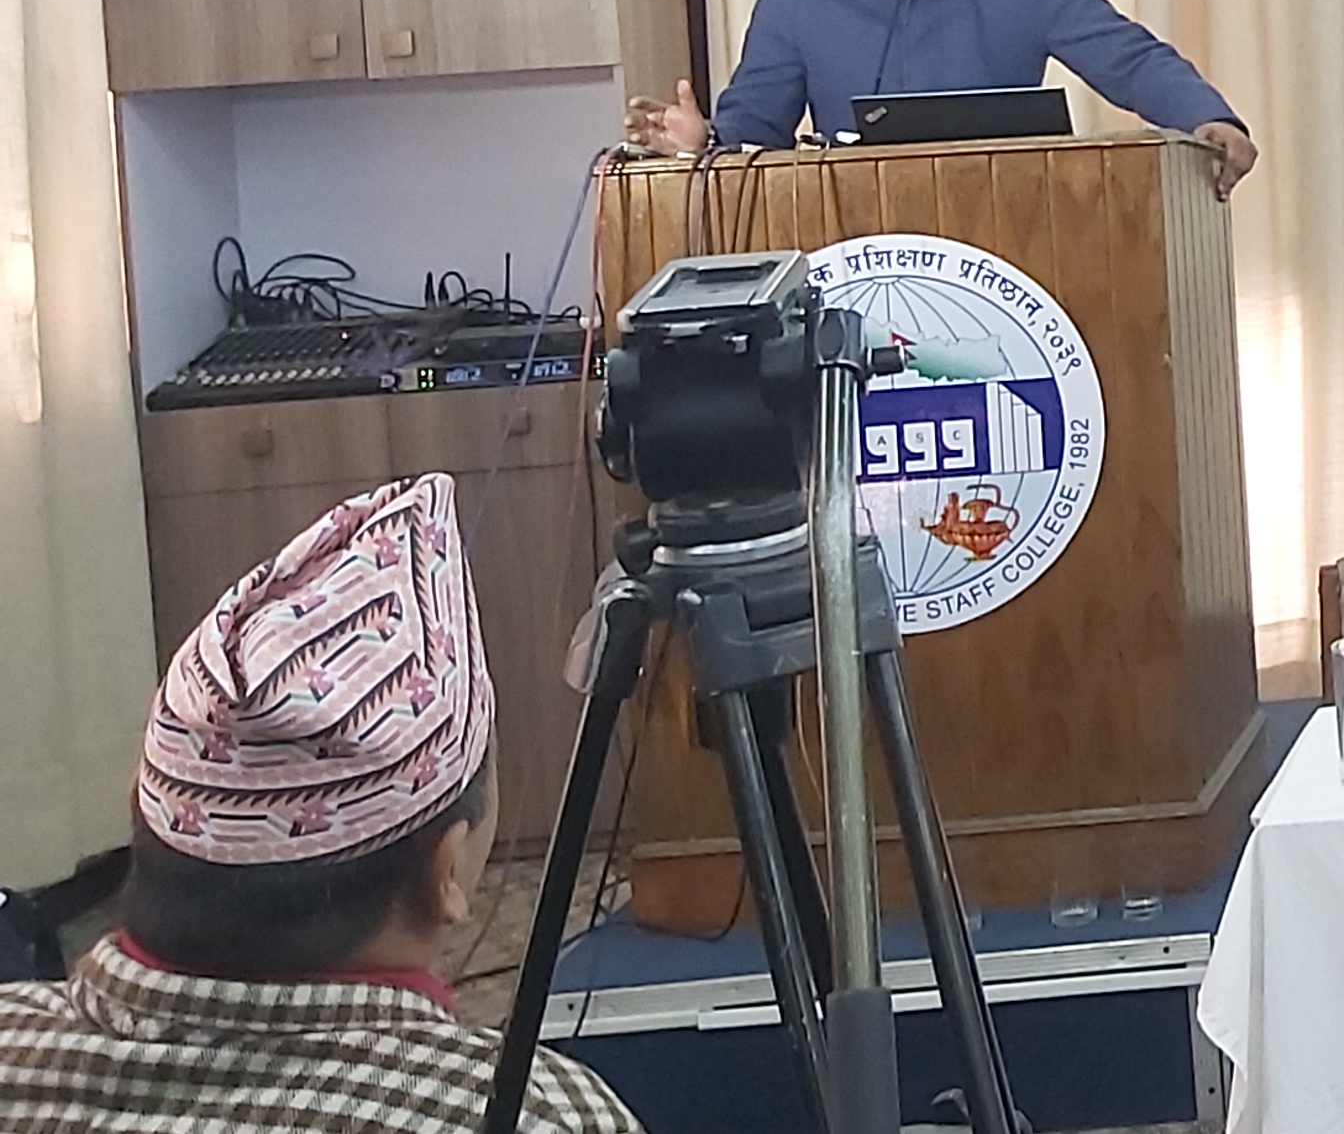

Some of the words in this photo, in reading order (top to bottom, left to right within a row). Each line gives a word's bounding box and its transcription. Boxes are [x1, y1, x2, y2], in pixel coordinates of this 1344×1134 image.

[845, 244, 947, 275] प्रशिक्षण
[960, 259, 1044, 327] प्रतिष्ठान,
[1042, 318, 1082, 377] २०३९
[925, 576, 996, 620] STAFF
[1001, 482, 1086, 584] COLLEGE,
[1068, 417, 1090, 470] 1982
